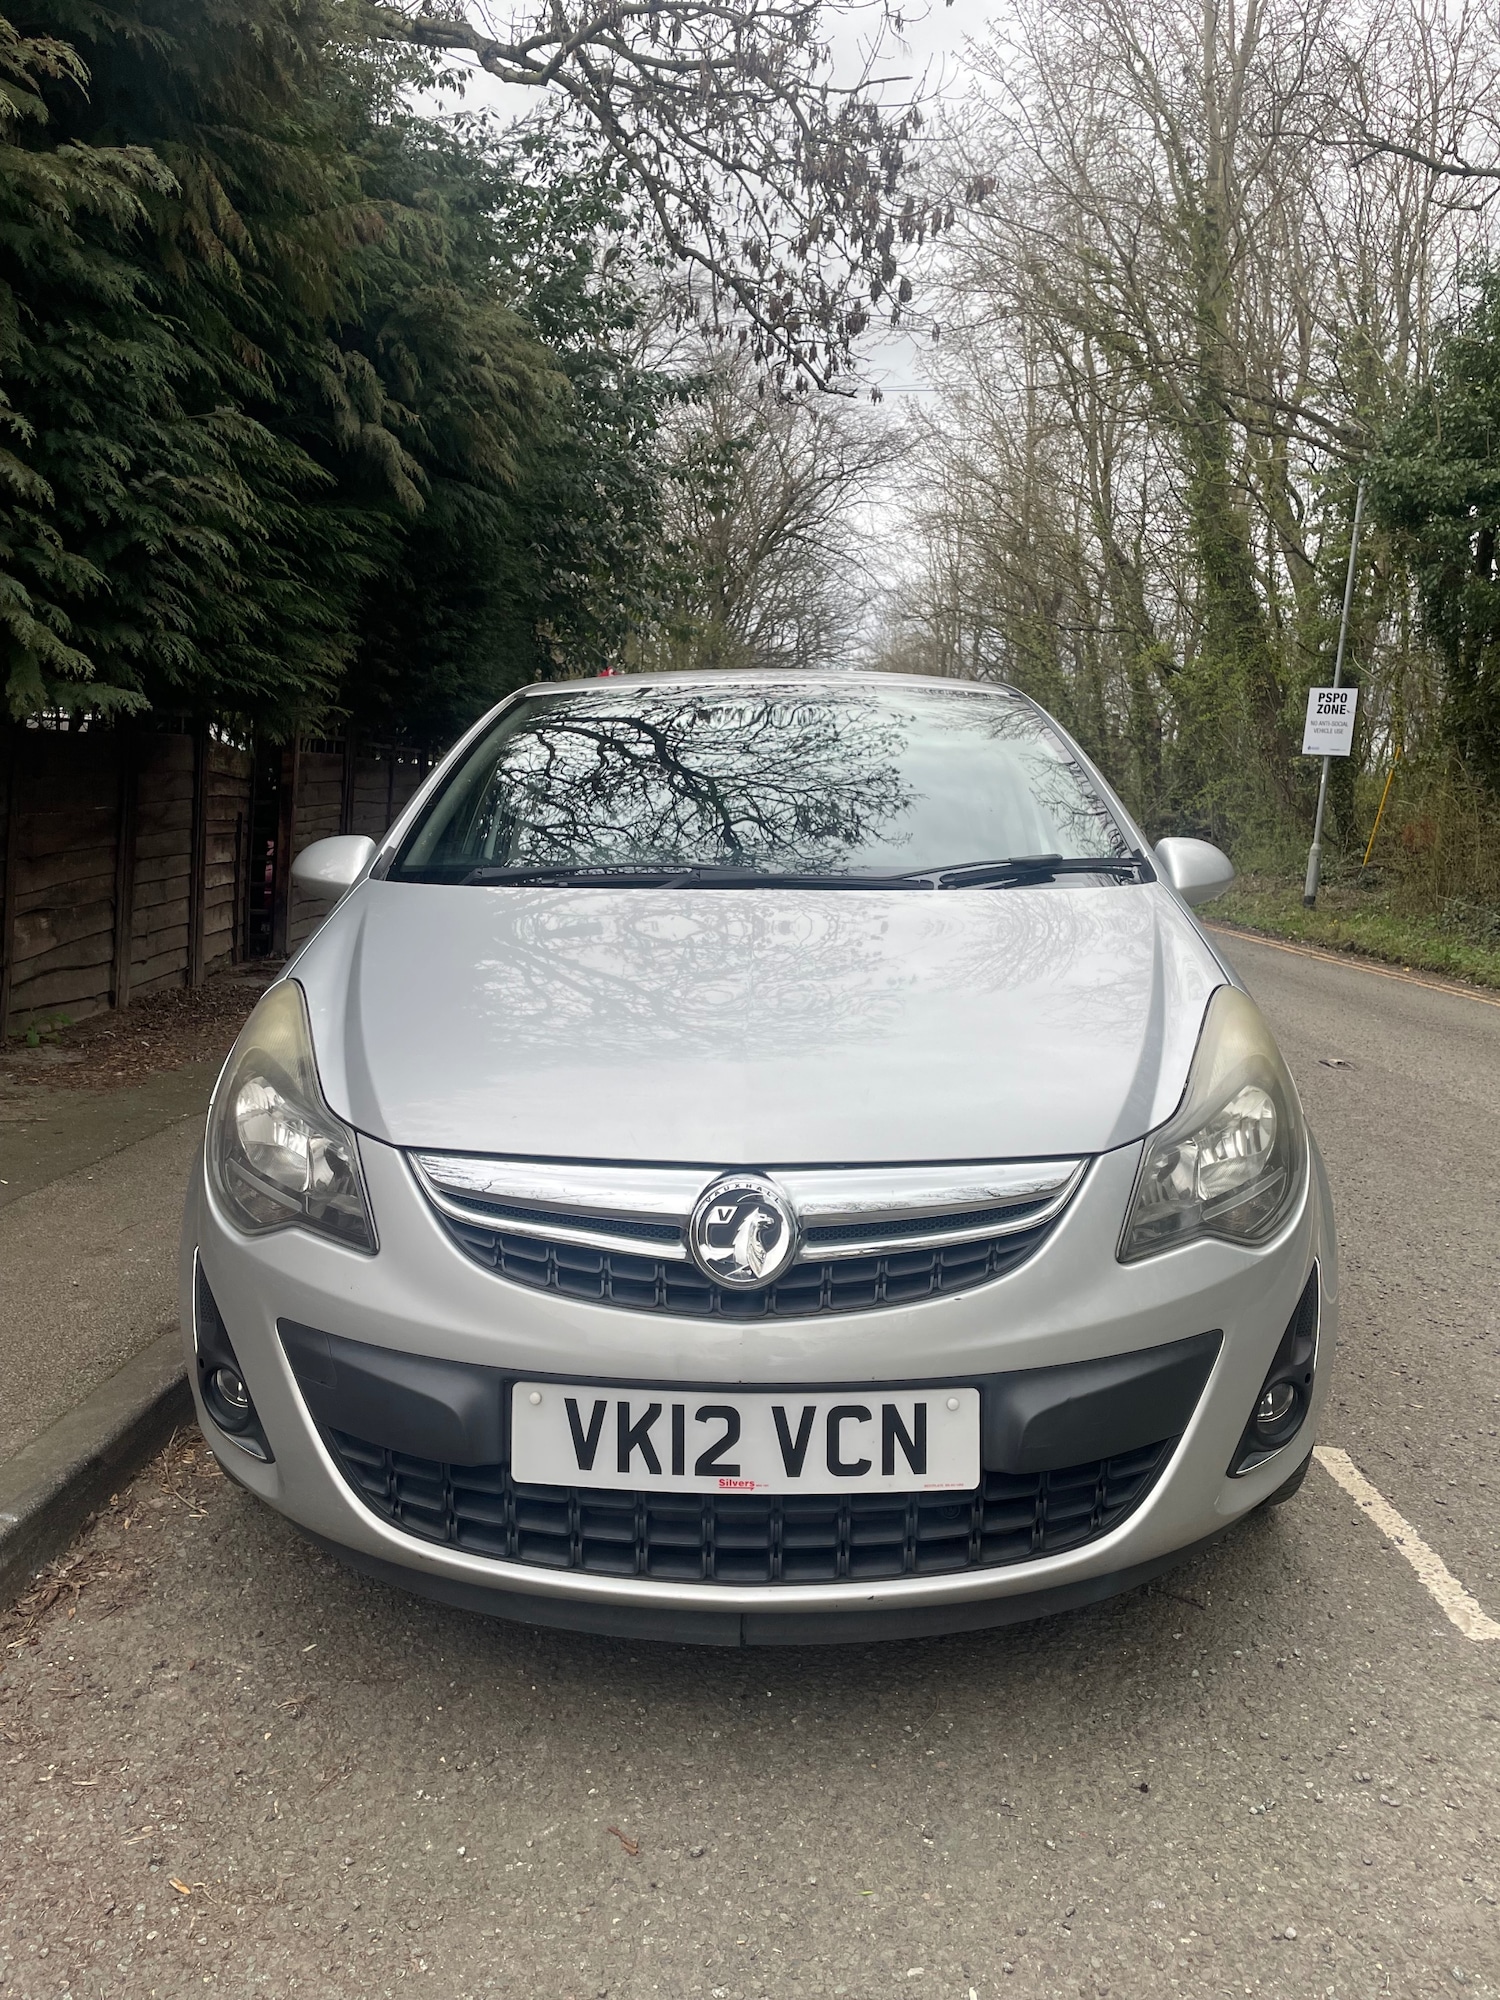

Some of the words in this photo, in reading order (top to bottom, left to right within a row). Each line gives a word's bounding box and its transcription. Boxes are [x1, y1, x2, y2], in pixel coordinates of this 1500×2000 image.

[1318, 692, 1348, 703] PSPO
[1316, 704, 1347, 715] ZONE
[705, 1183, 780, 1204] VAUXHALL
[563, 1397, 741, 1477] VK12
[771, 1402, 927, 1478] VCN
[718, 1478, 755, 1487] Silvers
